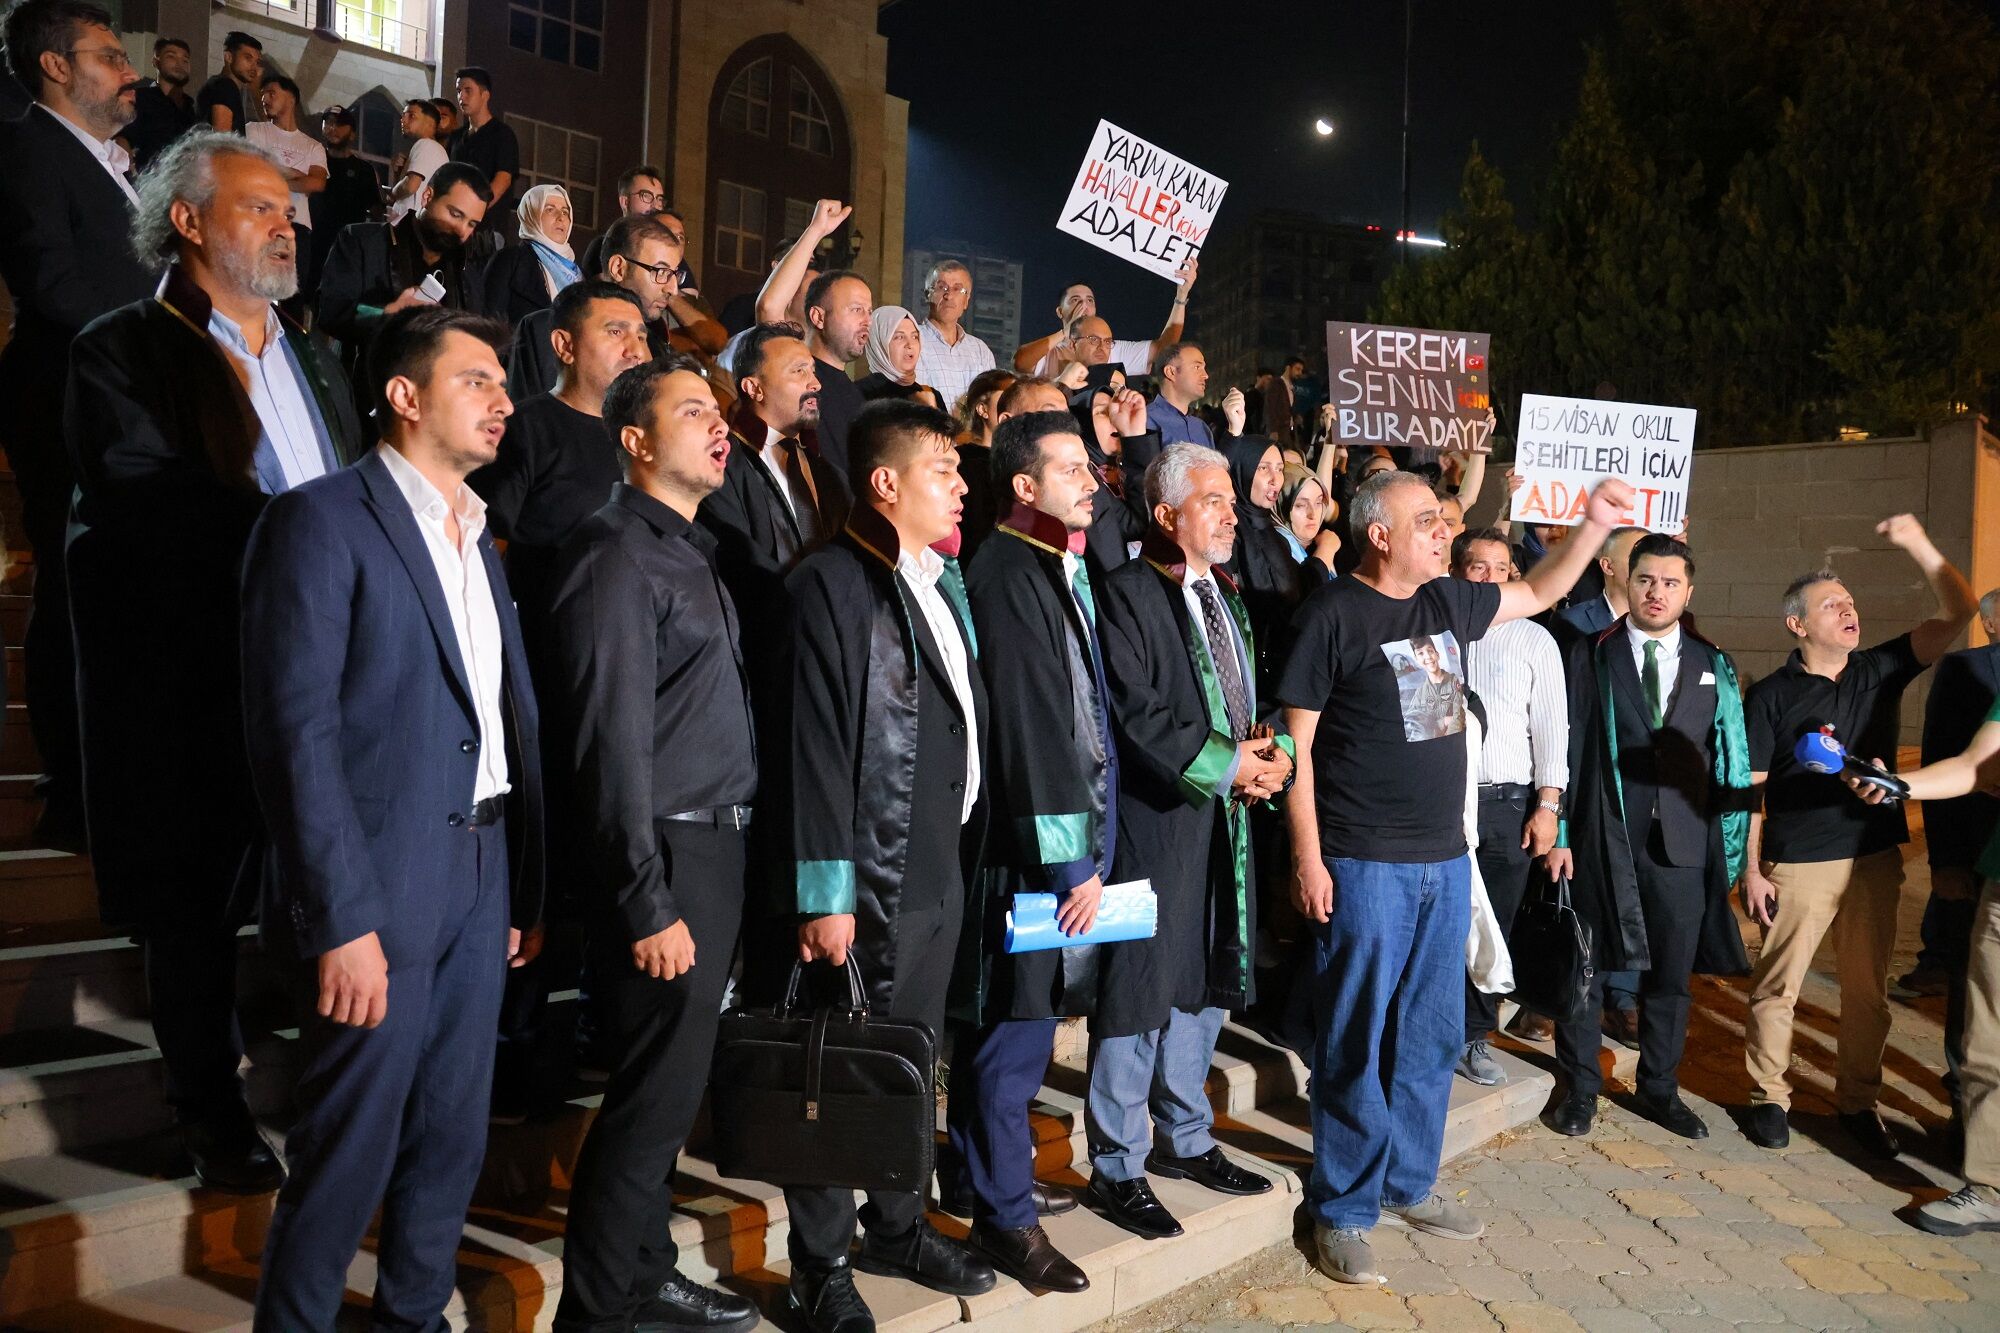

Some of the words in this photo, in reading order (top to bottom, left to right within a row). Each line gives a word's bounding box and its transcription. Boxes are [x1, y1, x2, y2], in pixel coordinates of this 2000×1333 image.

[1104, 128, 1167, 188] YARIM
[1081, 159, 1181, 231] HAYALLER
[1069, 199, 1201, 270] ADALET
[1350, 328, 1467, 374] KEREM
[1338, 408, 1493, 452] BURADAYIZ
[1527, 406, 1550, 431] 15
[1553, 403, 1620, 437] NİSAN
[1632, 414, 1680, 443] OKUL
[1641, 446, 1687, 479] İÇİN
[1519, 480, 1680, 529] ADAET!!!
